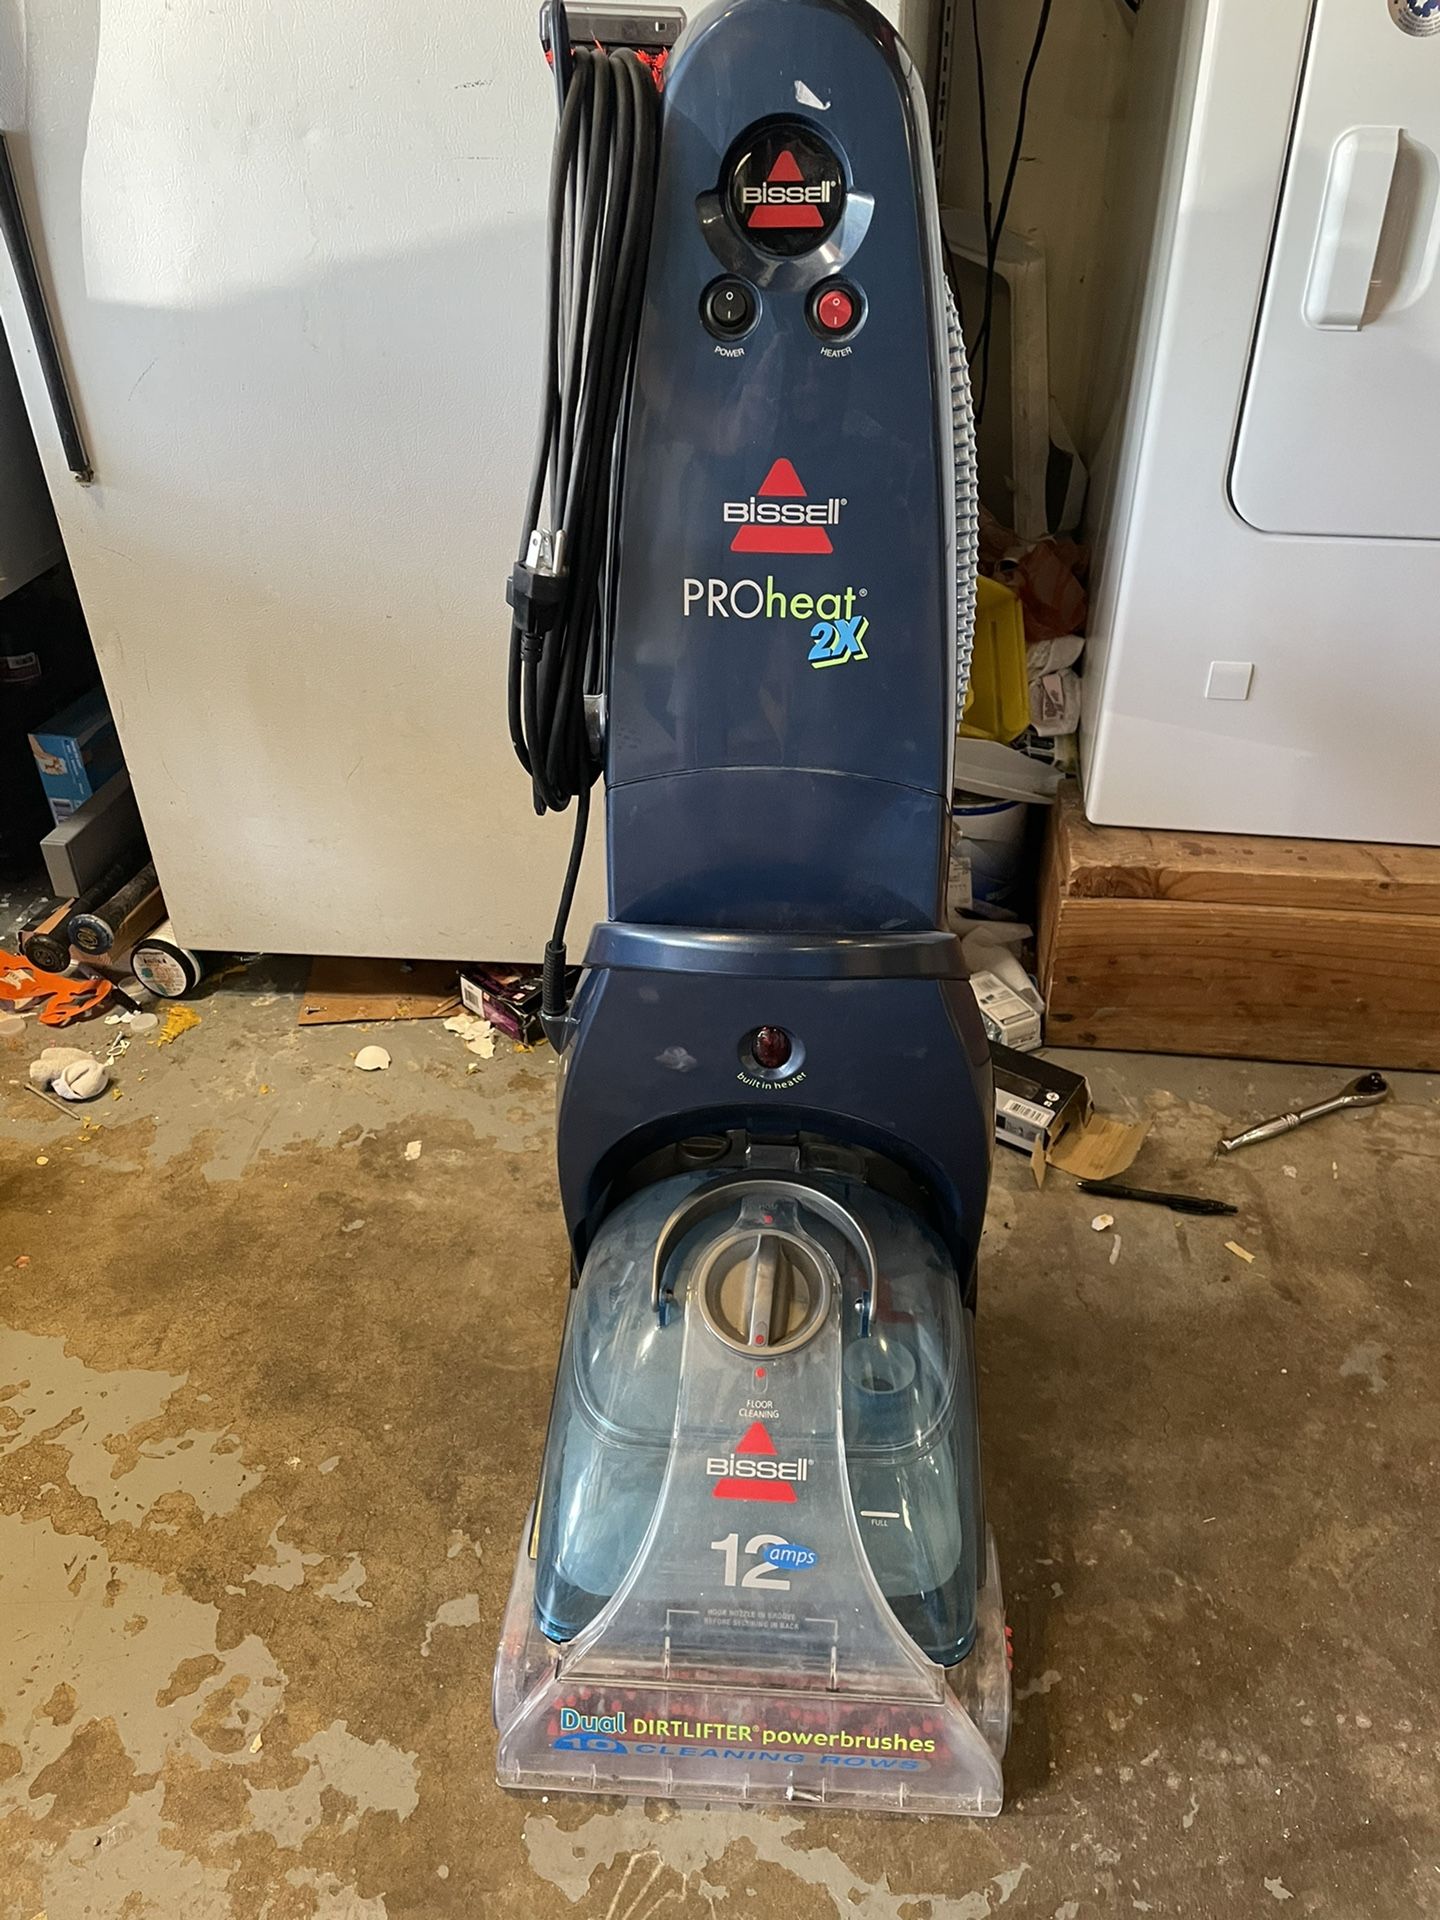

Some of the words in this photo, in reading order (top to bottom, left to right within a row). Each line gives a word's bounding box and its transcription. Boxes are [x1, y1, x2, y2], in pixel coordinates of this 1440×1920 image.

[714, 345, 746, 358] POWER
[820, 346, 853, 358] HEATER
[683, 575, 857, 620] PROheat
[807, 615, 869, 668] 2X
[736, 1071, 761, 1089] built
[761, 1081, 772, 1090] in
[773, 1071, 807, 1090] heater
[738, 1407, 780, 1419] CLEANING
[746, 1399, 774, 1409] FLOOR
[871, 1518, 889, 1528] FULL
[711, 1533, 791, 1591] 12
[769, 1546, 816, 1567] amps
[560, 1707, 628, 1735] Dual
[633, 1717, 753, 1742] DIRTLIFTER
[762, 1729, 936, 1753] powerbrushes
[561, 1736, 618, 1752] 10
[635, 1744, 805, 1764] CLEANING
[820, 1755, 920, 1771] ROWS
